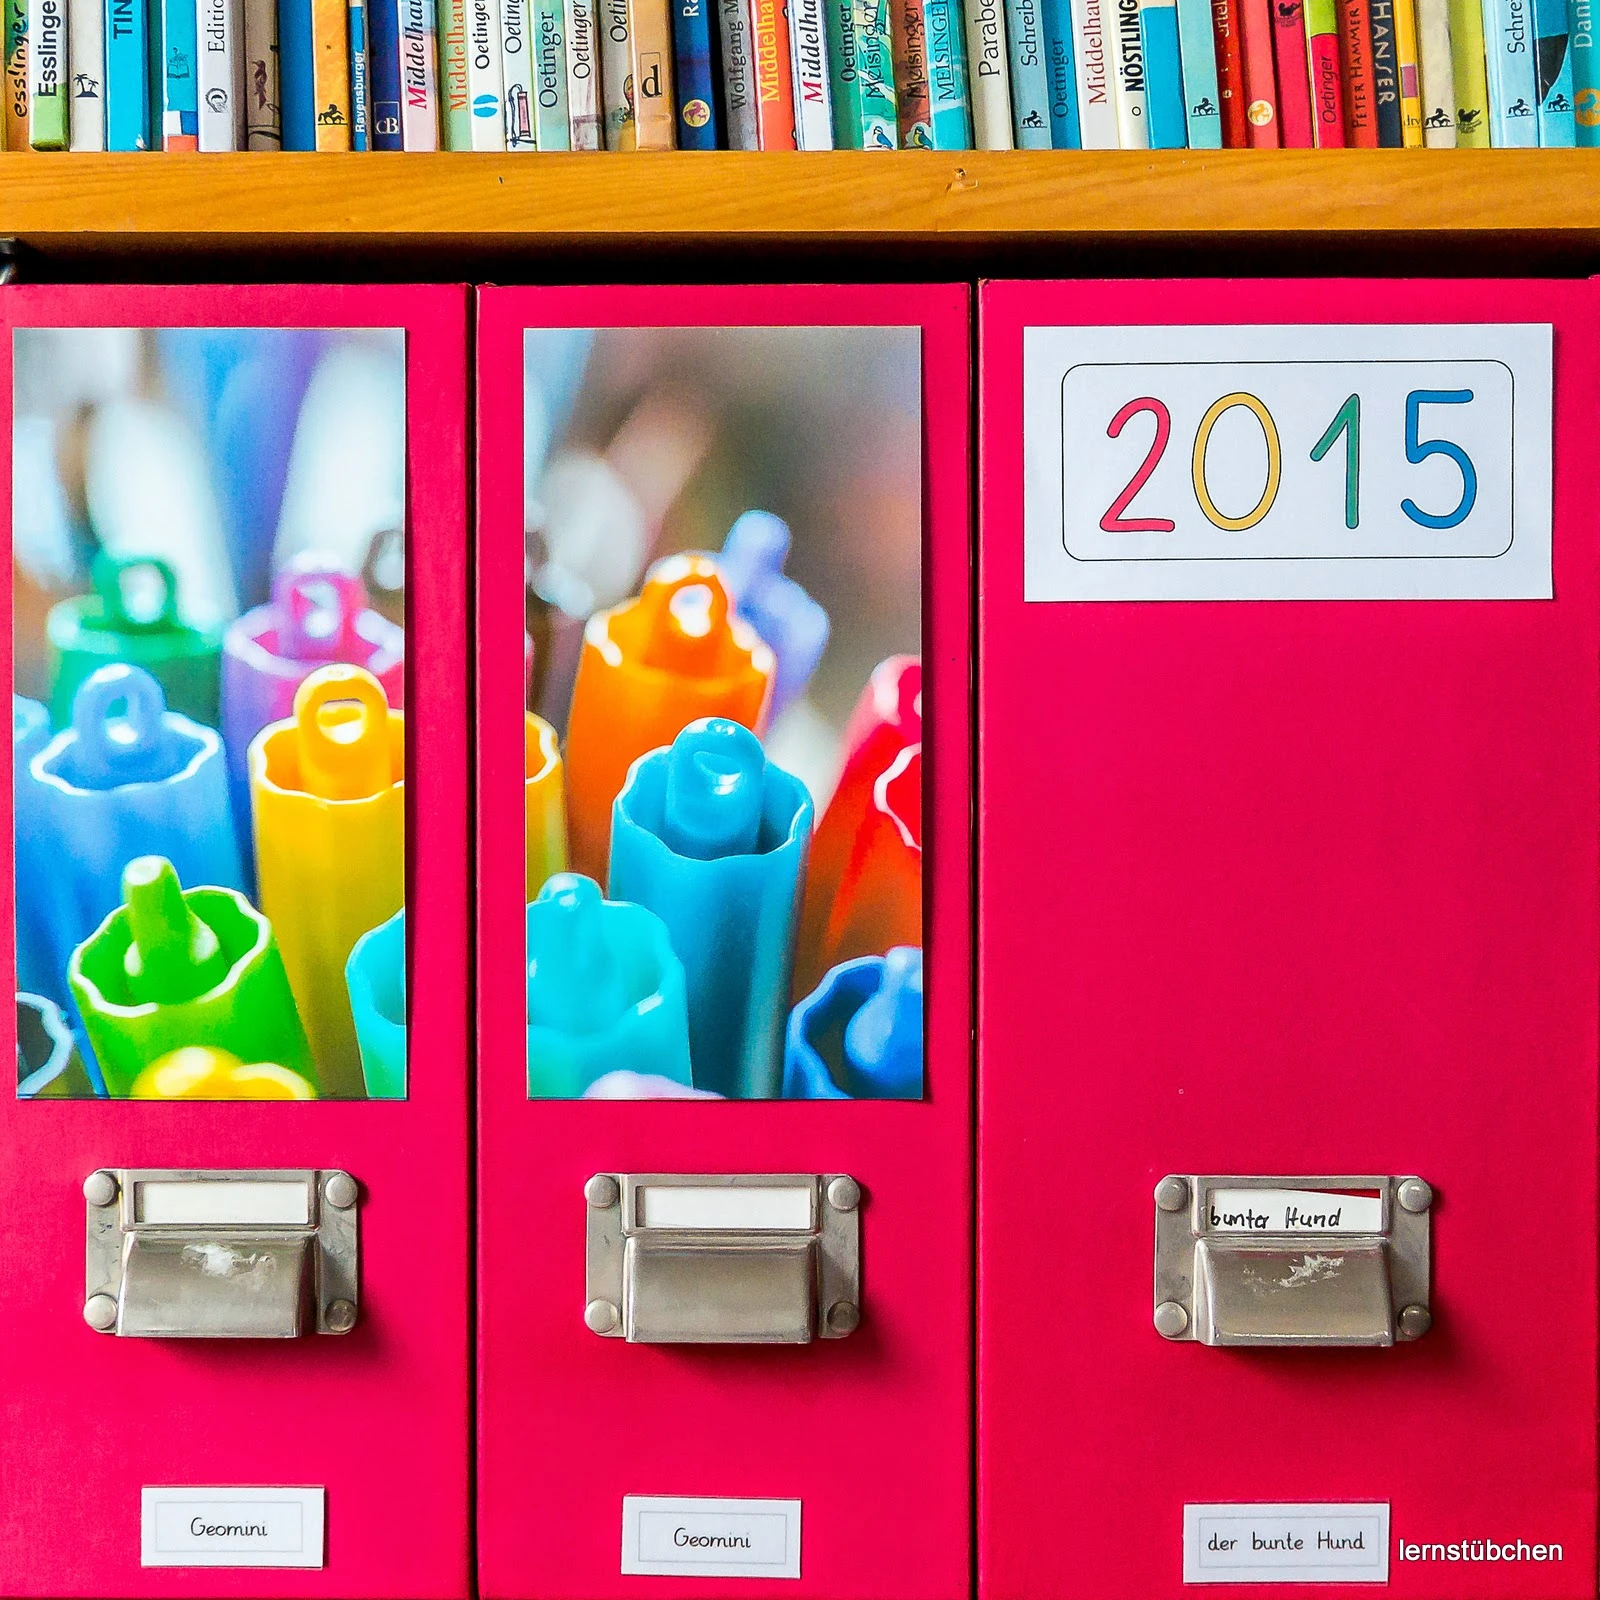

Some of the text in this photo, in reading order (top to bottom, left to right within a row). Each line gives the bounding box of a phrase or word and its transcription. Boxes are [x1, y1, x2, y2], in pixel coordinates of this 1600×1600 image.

[38, 0, 61, 97] Esslinge
[113, 0, 133, 40] TIN
[472, 0, 491, 69] Oetinge
[538, 11, 562, 108] Oetinger
[570, 0, 593, 79] Oetinger
[608, 0, 628, 43] Oeti
[757, 0, 780, 103] Middelha
[838, 4, 857, 82] Oetinger
[862, 1, 887, 99] Meisinger
[902, 2, 926, 99] Meisinger
[974, 0, 1000, 78] Parabe
[1016, 0, 1038, 66] Schreib
[1118, 0, 1145, 92] NÖSTLING
[1372, 1, 1396, 105] HANSER
[1504, 0, 1525, 53] Schre
[352, 50, 367, 133] Ravensburger
[729, 20, 748, 110] Wolfgang
[1050, 39, 1070, 118] Oetinger
[1320, 56, 1339, 124] Oetinger
[1350, 8, 1368, 129] PETER HAMMER
[1100, 389, 1477, 532] 2015
[1285, 1206, 1342, 1229] Hund
[190, 1516, 268, 1537] Geomini
[673, 1527, 751, 1548] Geomini
[1207, 1530, 1366, 1552] der bunte Hund
